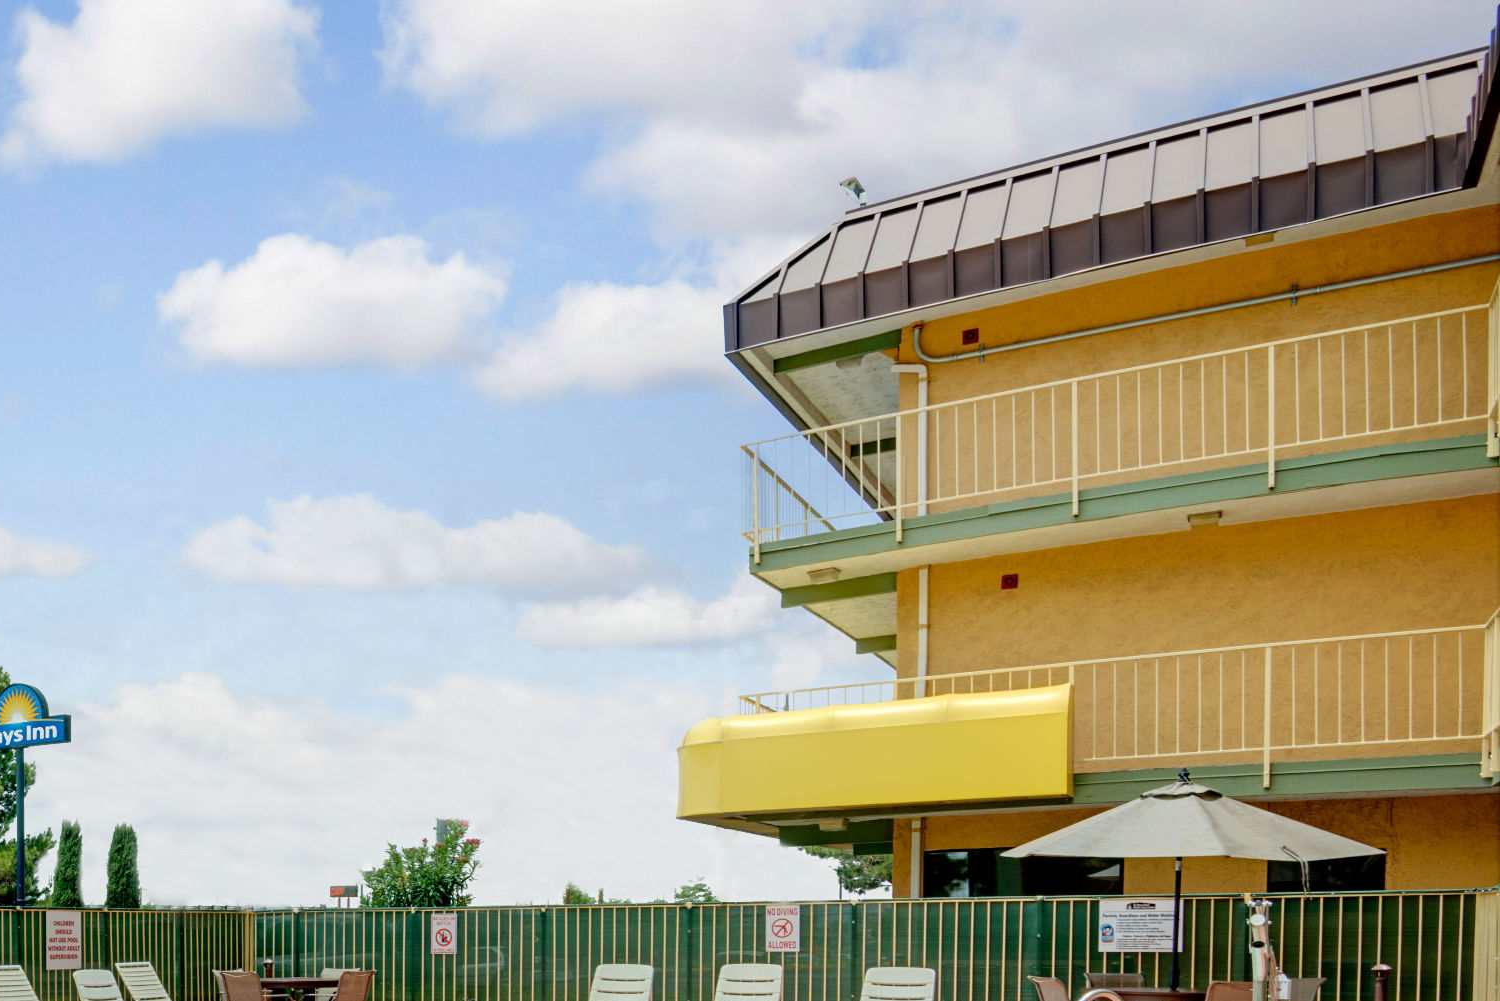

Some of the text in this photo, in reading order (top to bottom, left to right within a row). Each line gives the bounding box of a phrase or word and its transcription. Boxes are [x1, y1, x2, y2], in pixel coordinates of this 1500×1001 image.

[26, 725, 57, 741] Inn
[766, 907, 798, 916] NO DIVING
[768, 940, 797, 949] ALLOWED
